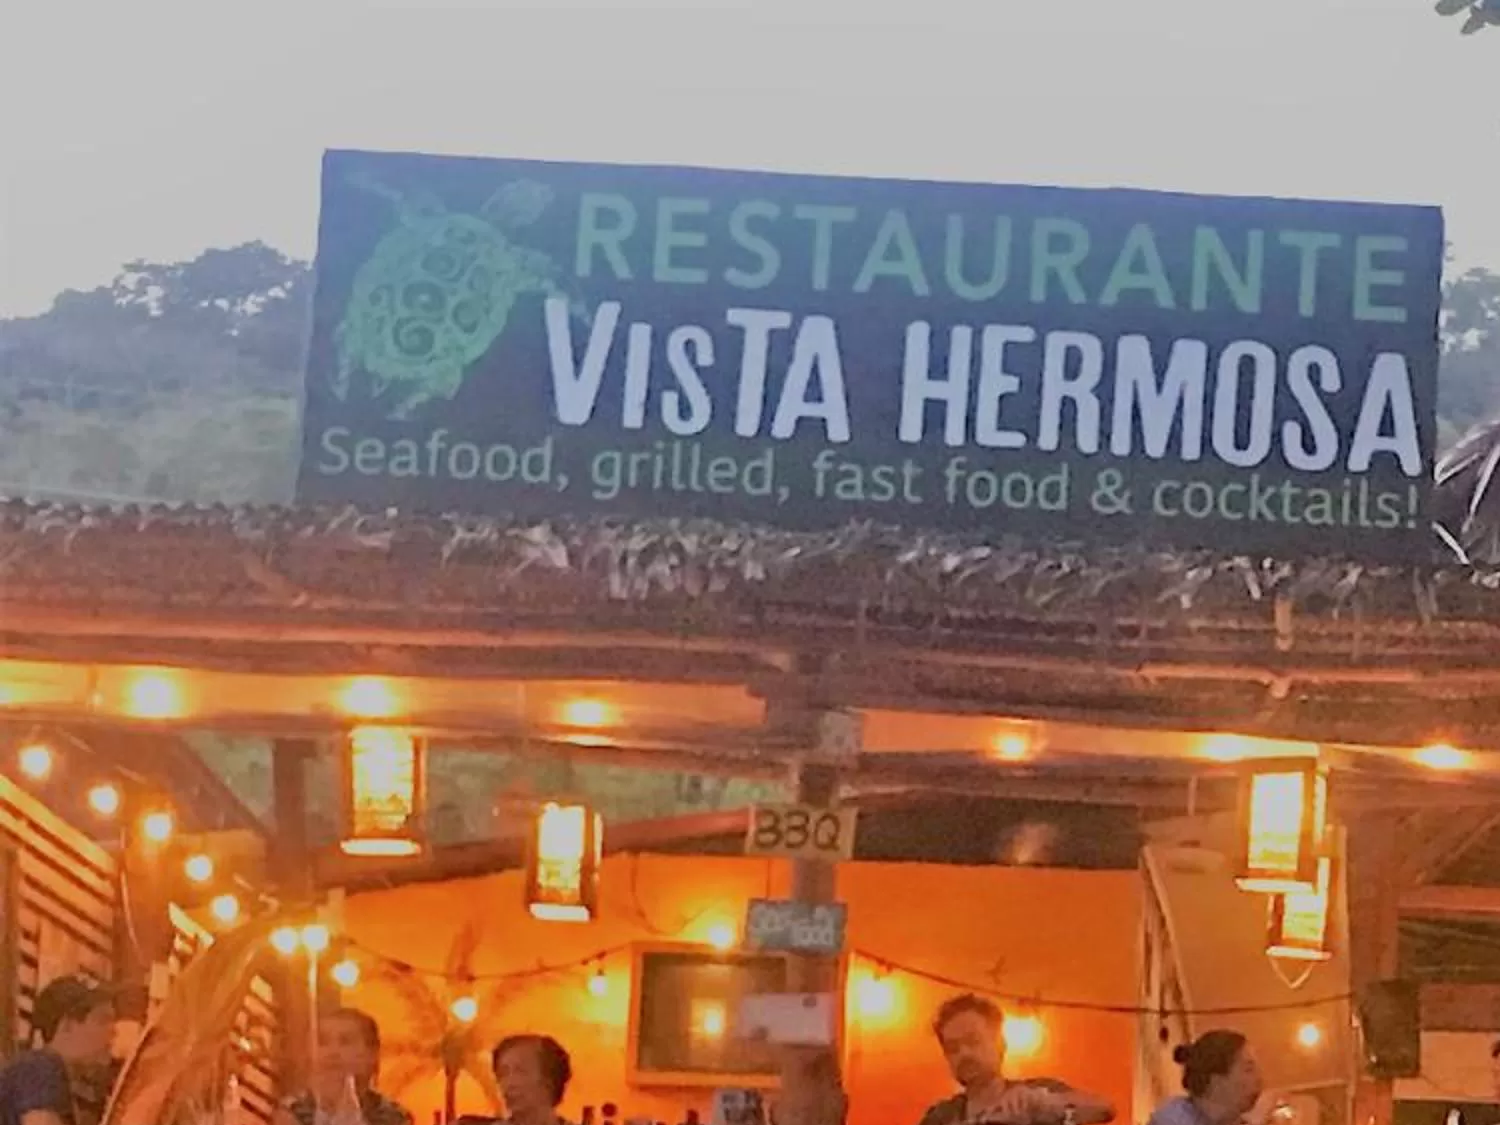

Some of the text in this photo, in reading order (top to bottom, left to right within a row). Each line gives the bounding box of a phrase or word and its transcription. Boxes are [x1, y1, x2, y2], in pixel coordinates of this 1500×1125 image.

[573, 191, 1408, 324] RESTAURANTE
[544, 297, 1424, 477] VISTA HERMOSA
[318, 426, 1419, 530] Seafood, grilled, fast food & cocktails!
[754, 809, 841, 851] BBQ
